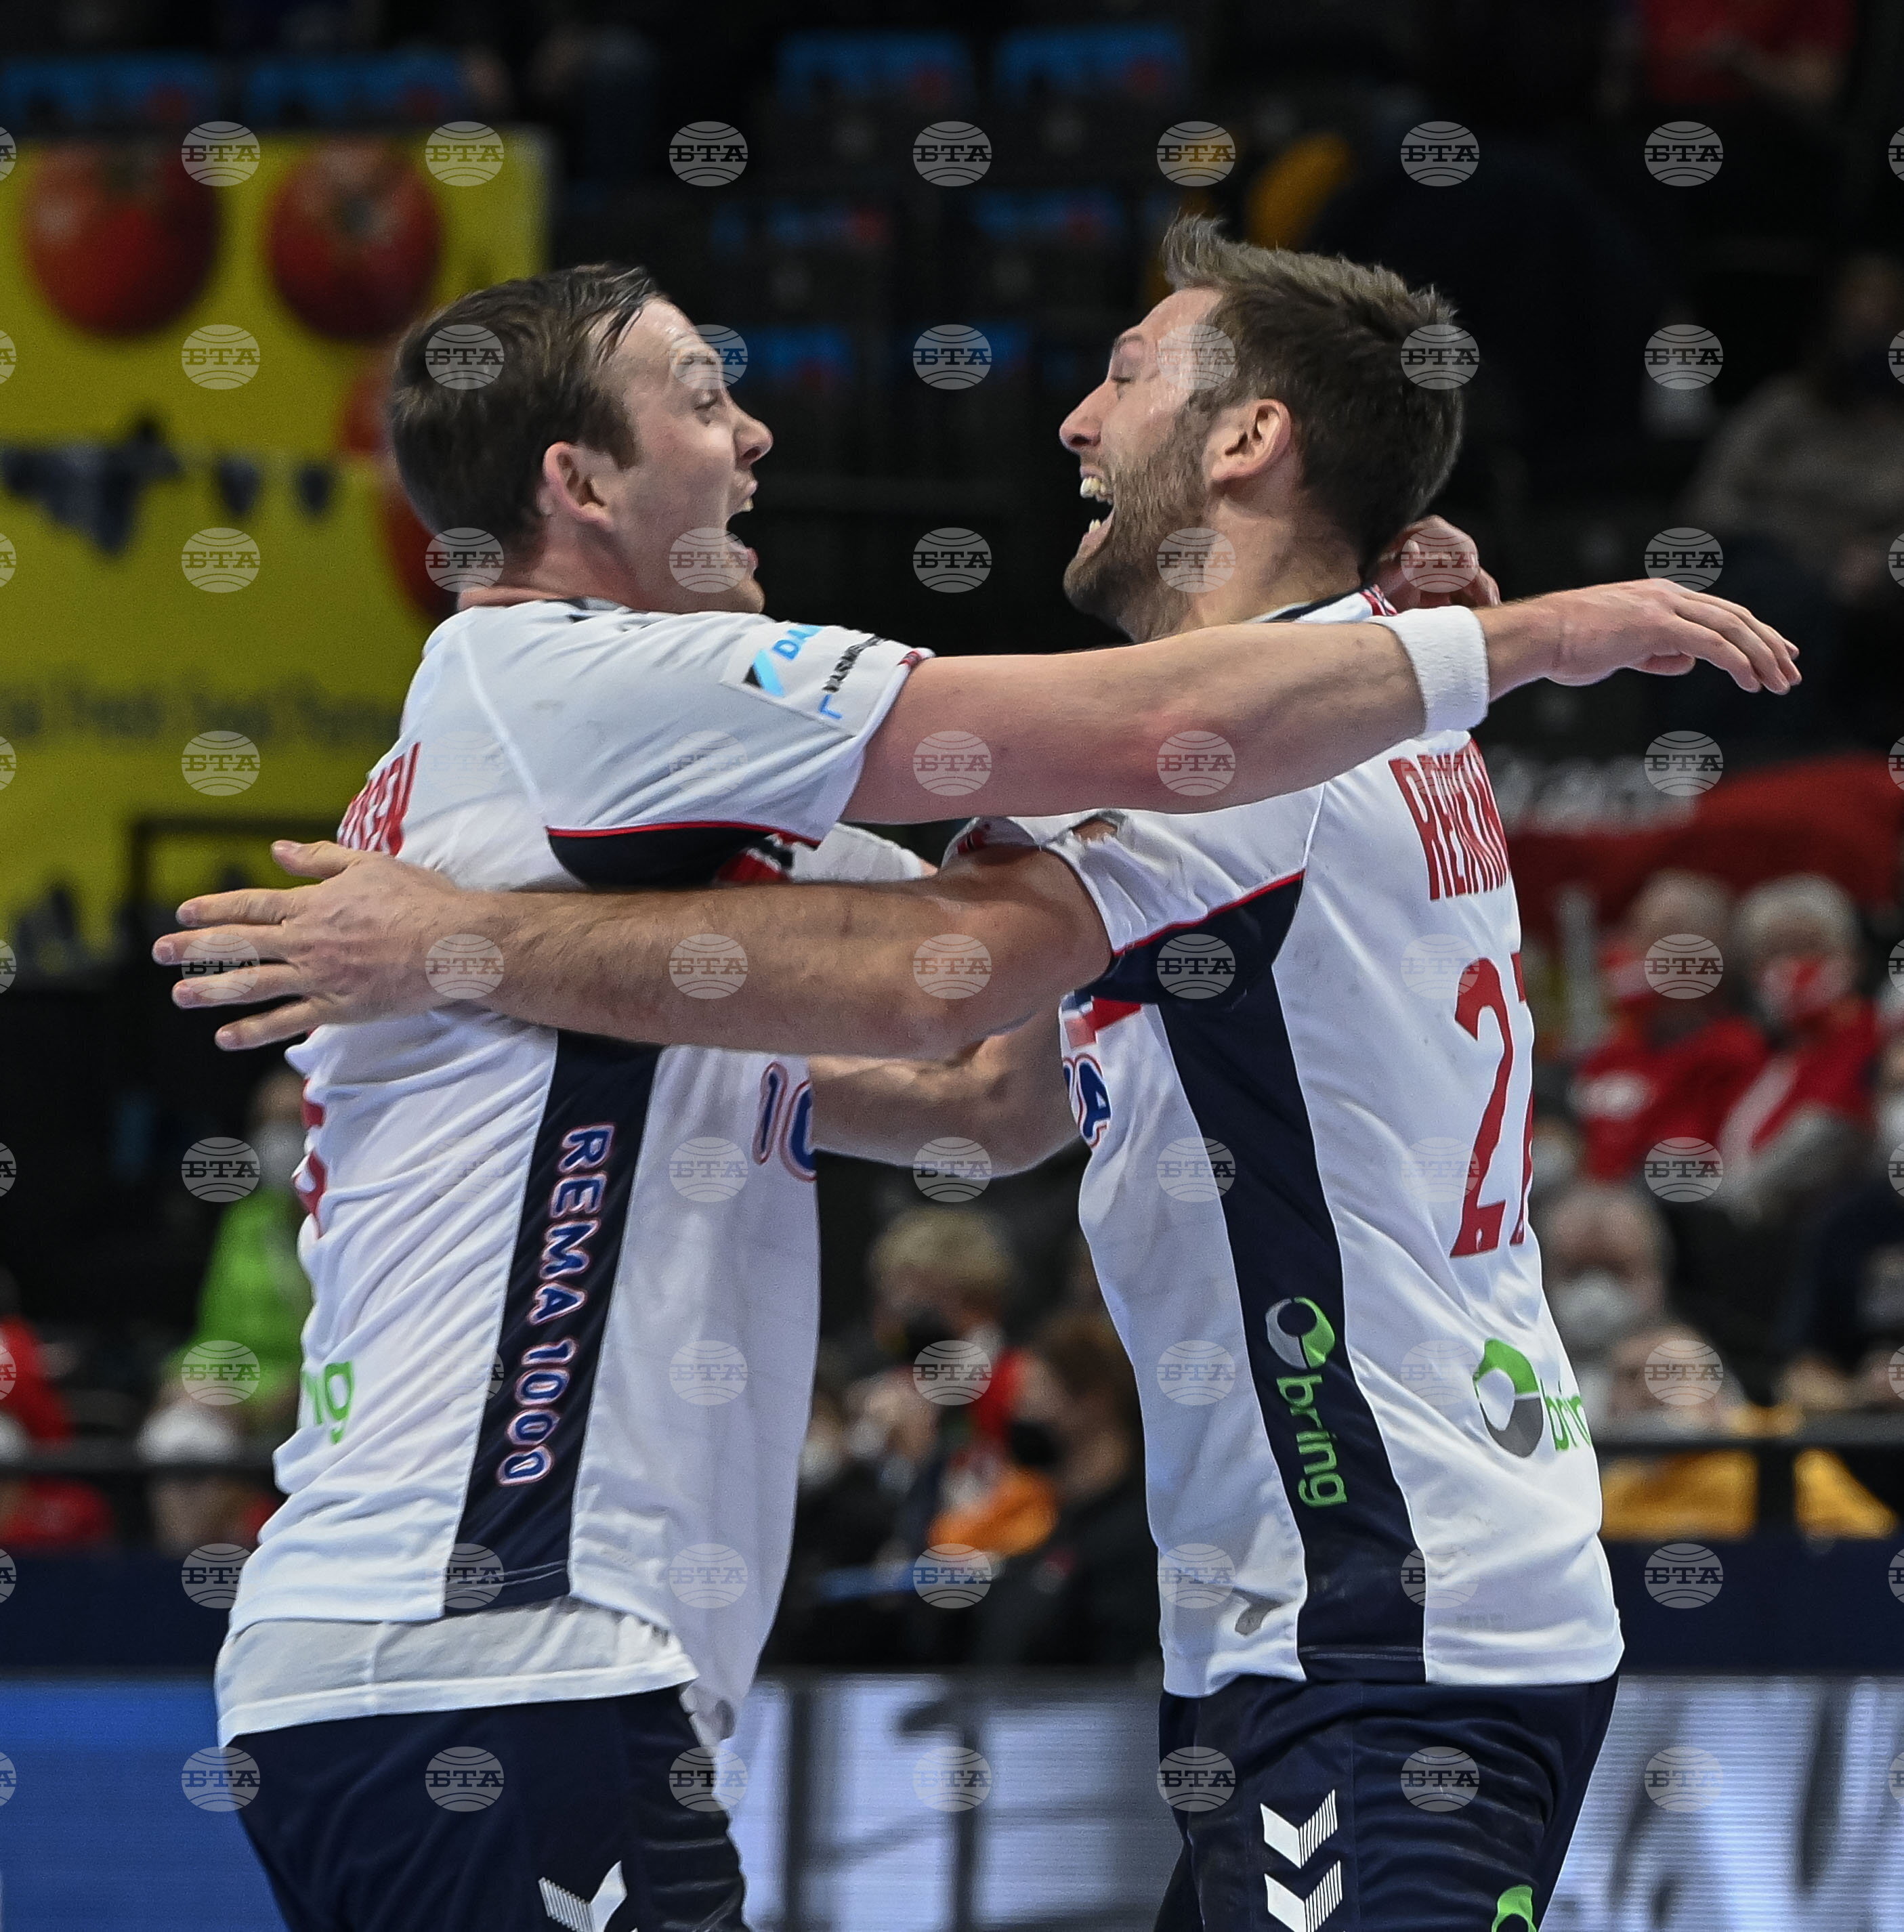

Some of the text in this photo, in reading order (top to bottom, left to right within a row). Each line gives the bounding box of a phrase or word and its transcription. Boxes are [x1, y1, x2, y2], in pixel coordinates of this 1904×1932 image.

[496, 1123, 615, 1486] REMA 1000
[1276, 1374, 1347, 1507] bring
